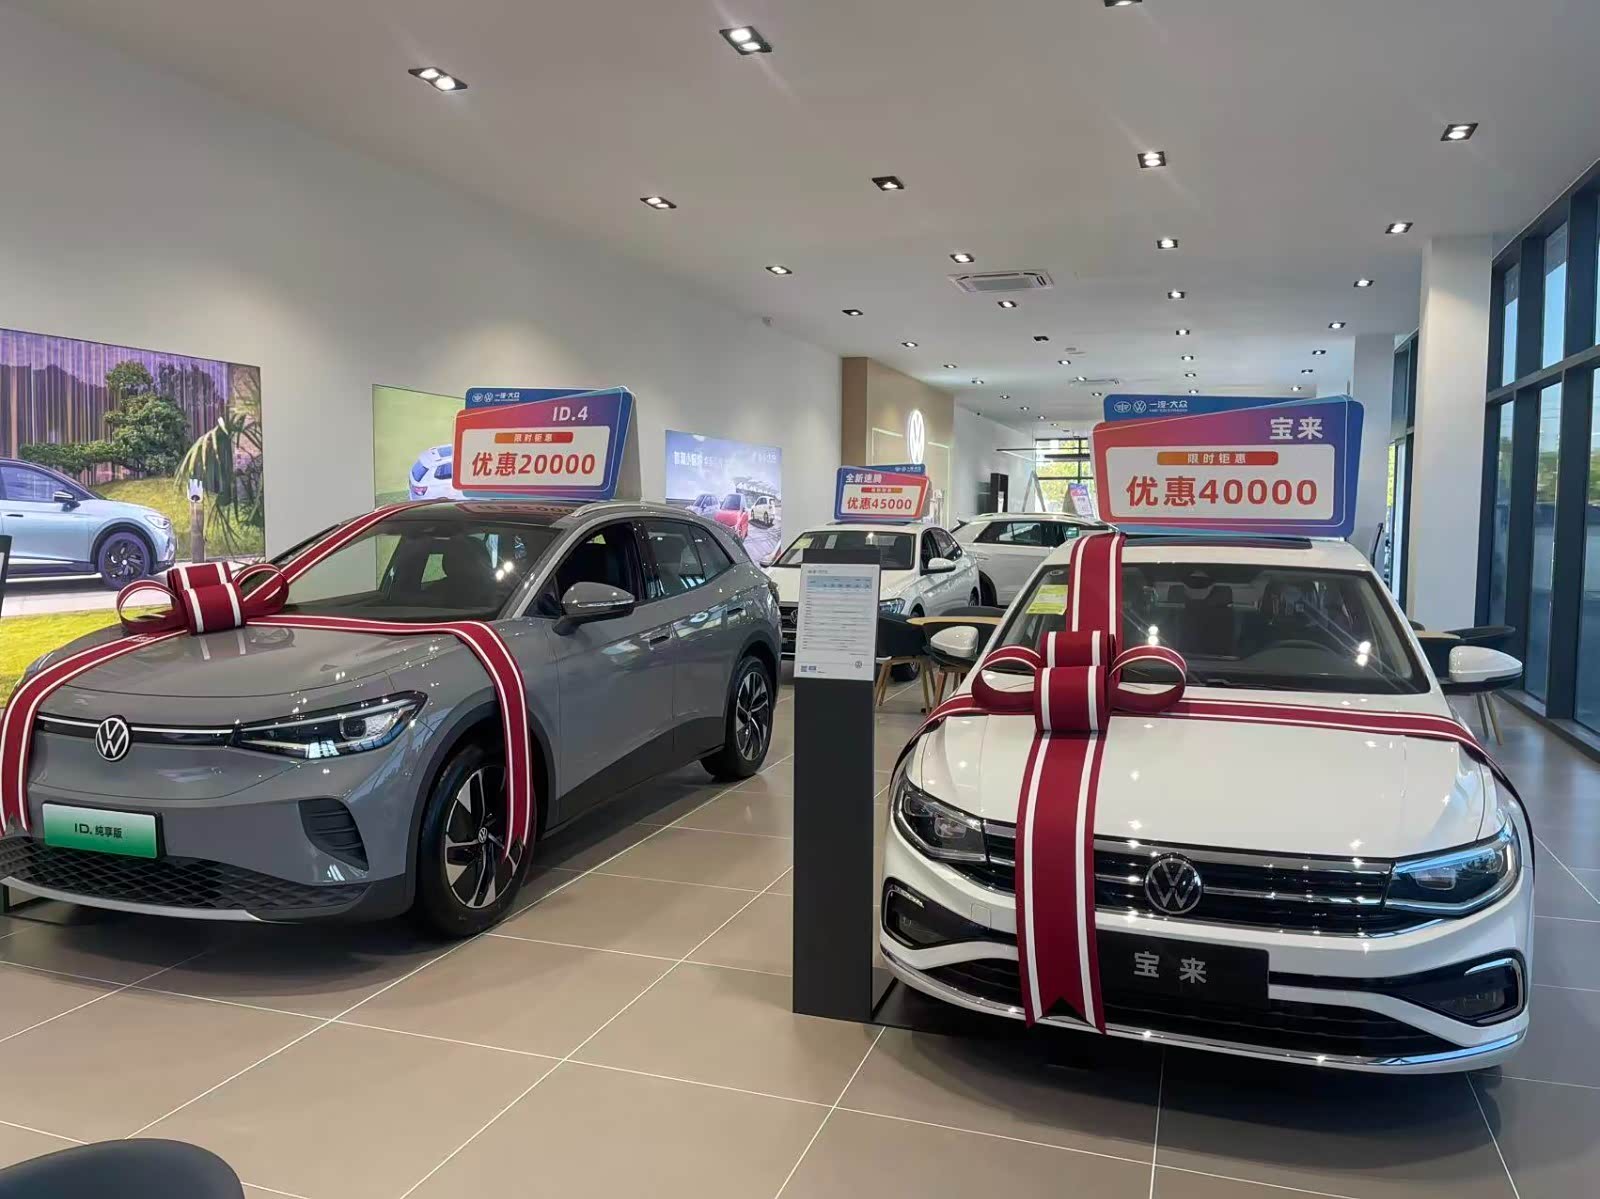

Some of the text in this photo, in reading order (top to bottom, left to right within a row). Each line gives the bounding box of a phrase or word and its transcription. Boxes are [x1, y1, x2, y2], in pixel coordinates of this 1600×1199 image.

[552, 406, 588, 422] ID.4
[1269, 416, 1323, 440] 宝来
[472, 452, 596, 477] 优惠20000
[1187, 453, 1246, 464] 限时钜惠
[1126, 475, 1317, 507] 优惠40000
[847, 497, 912, 509] 优惠45000
[74, 823, 92, 835] ID.
[1133, 950, 1207, 984] 宝来
